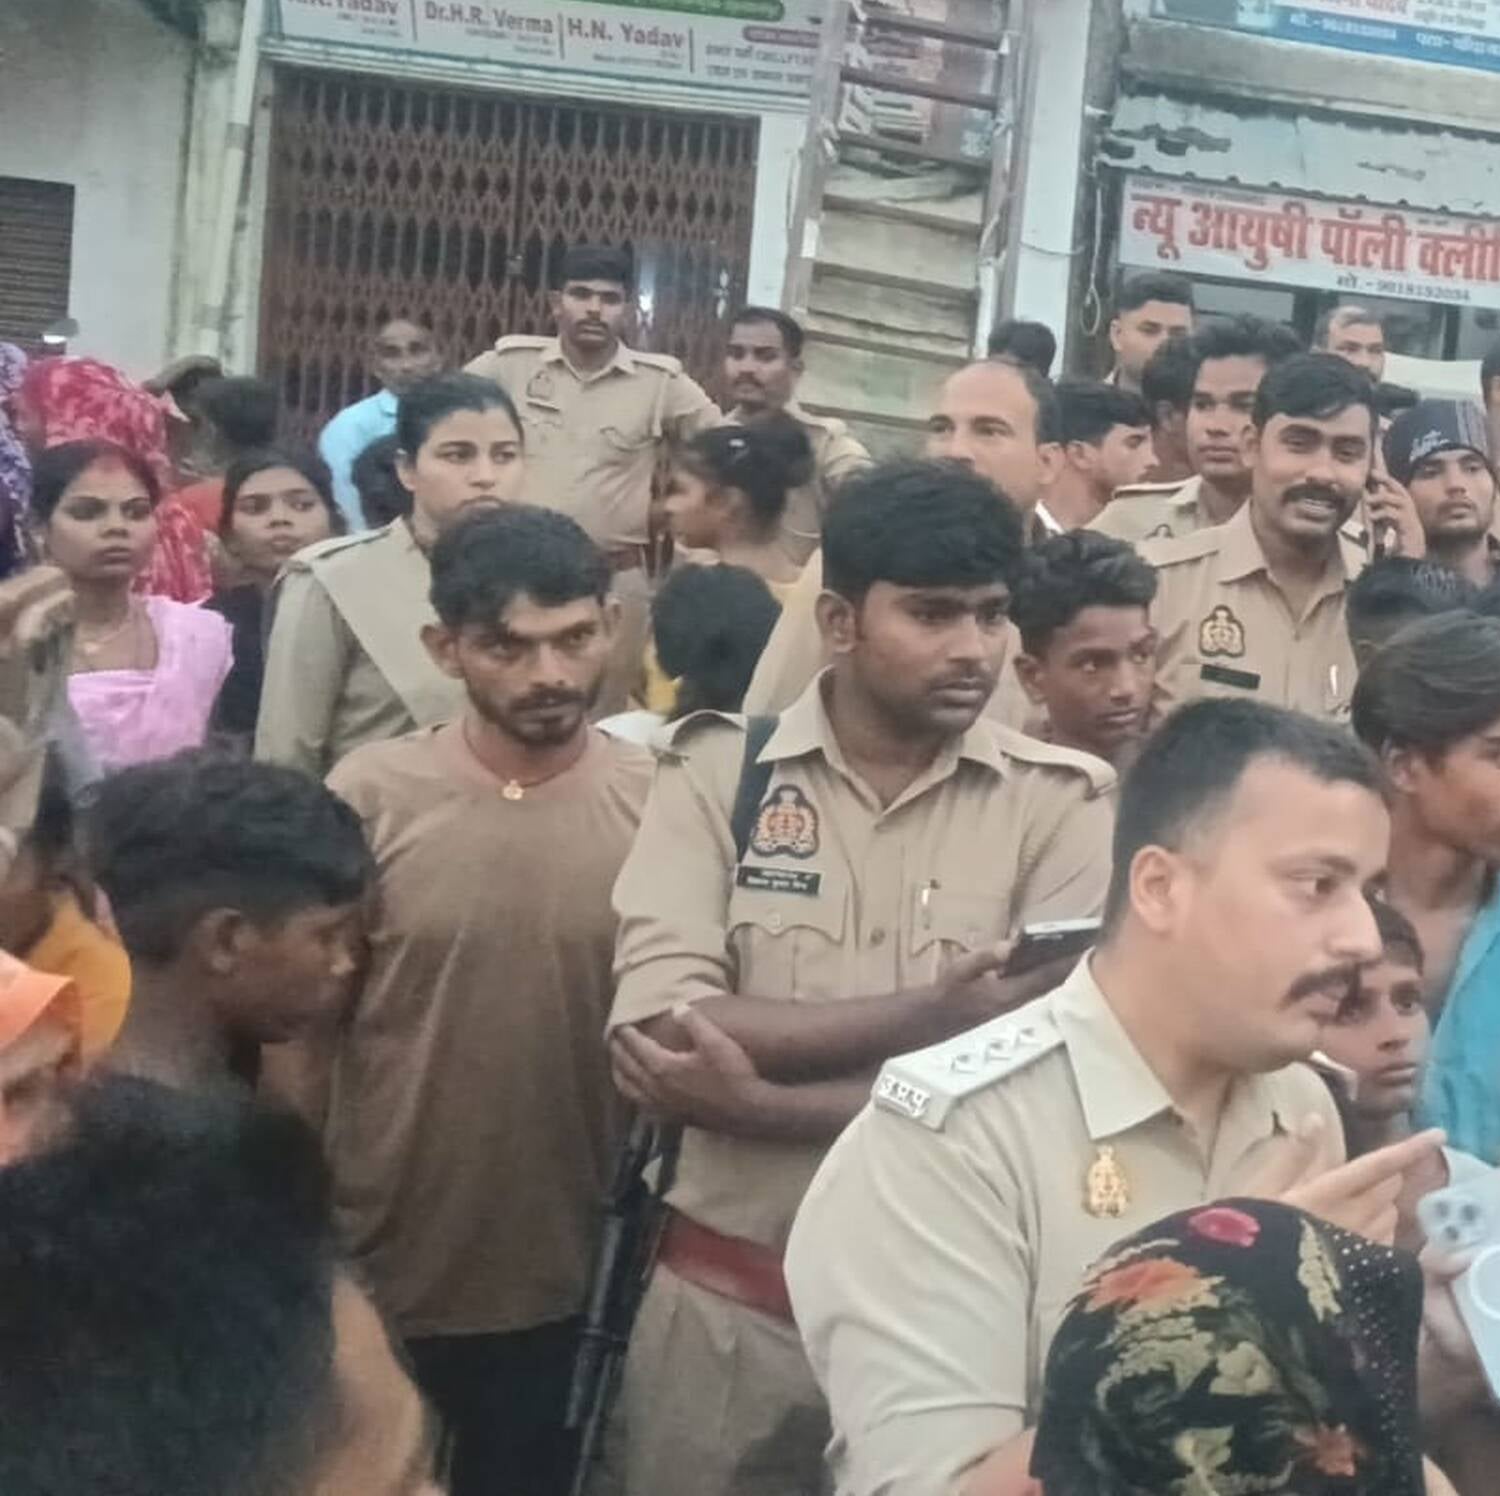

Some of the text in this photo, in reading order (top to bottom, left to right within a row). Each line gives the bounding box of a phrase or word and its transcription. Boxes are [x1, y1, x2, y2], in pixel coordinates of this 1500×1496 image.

[493, 9, 553, 34] Verma
[620, 23, 684, 49] Yadav
[1130, 192, 1183, 261] न्यू
[1187, 200, 1314, 271] आयुषी
[1319, 207, 1412, 271] पॉली
